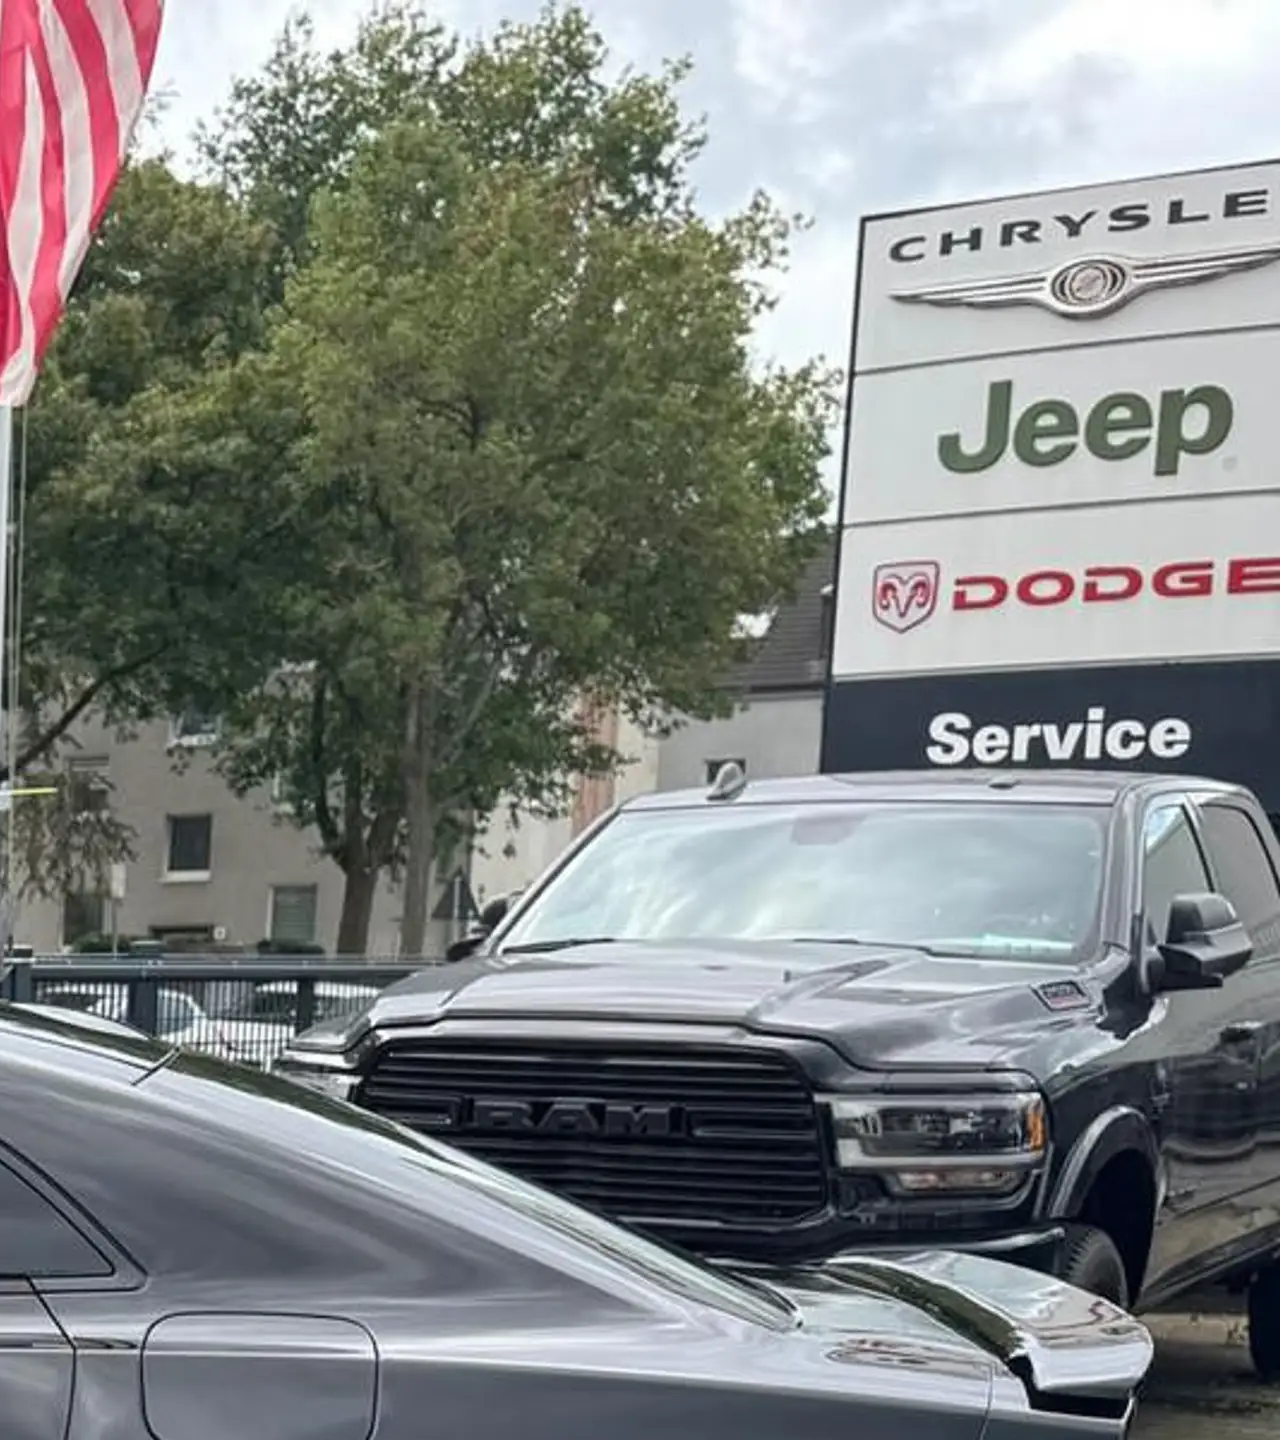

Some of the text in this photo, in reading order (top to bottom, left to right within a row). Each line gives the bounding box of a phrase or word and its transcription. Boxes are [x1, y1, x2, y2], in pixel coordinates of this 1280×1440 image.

[937, 379, 1234, 477] Jeep
[952, 557, 1280, 611] DODGE
[926, 706, 1192, 765] Service
[473, 1101, 670, 1134] RAM
